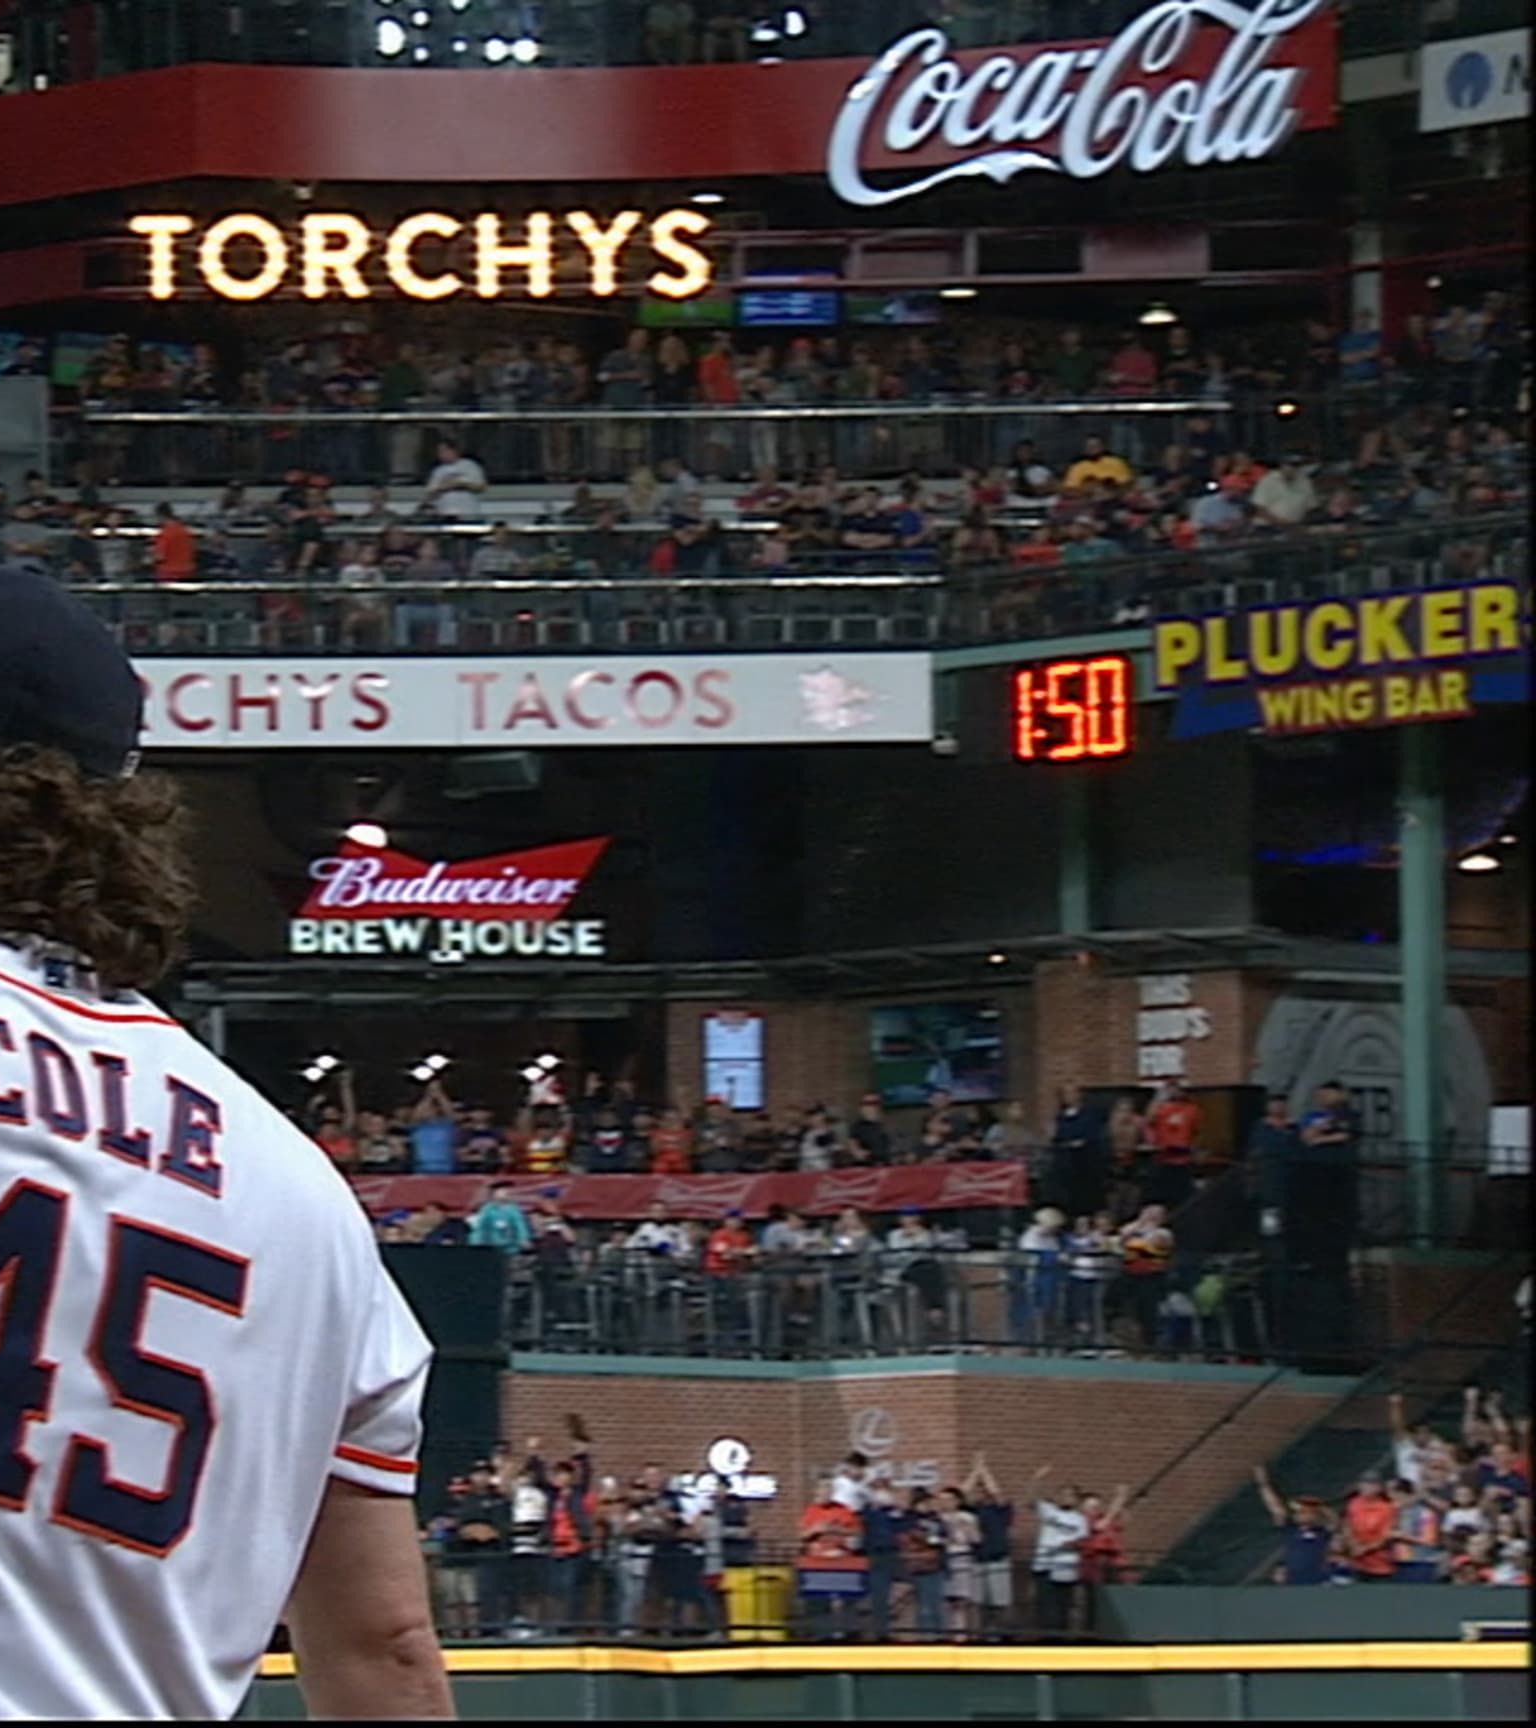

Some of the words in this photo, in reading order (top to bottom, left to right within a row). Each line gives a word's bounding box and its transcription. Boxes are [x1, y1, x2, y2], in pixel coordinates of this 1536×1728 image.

[828, 0, 1317, 206] Coca-Cola
[128, 208, 713, 300] TORCHYS
[1155, 584, 1530, 688] PLUCKER
[456, 669, 737, 729] TACOS
[1017, 659, 1126, 760] 1:50
[1260, 680, 1375, 729] WING
[1381, 671, 1470, 719] BAR
[309, 857, 579, 907] Budweiser
[290, 918, 430, 955] BREW
[438, 918, 606, 956] HOUSE
